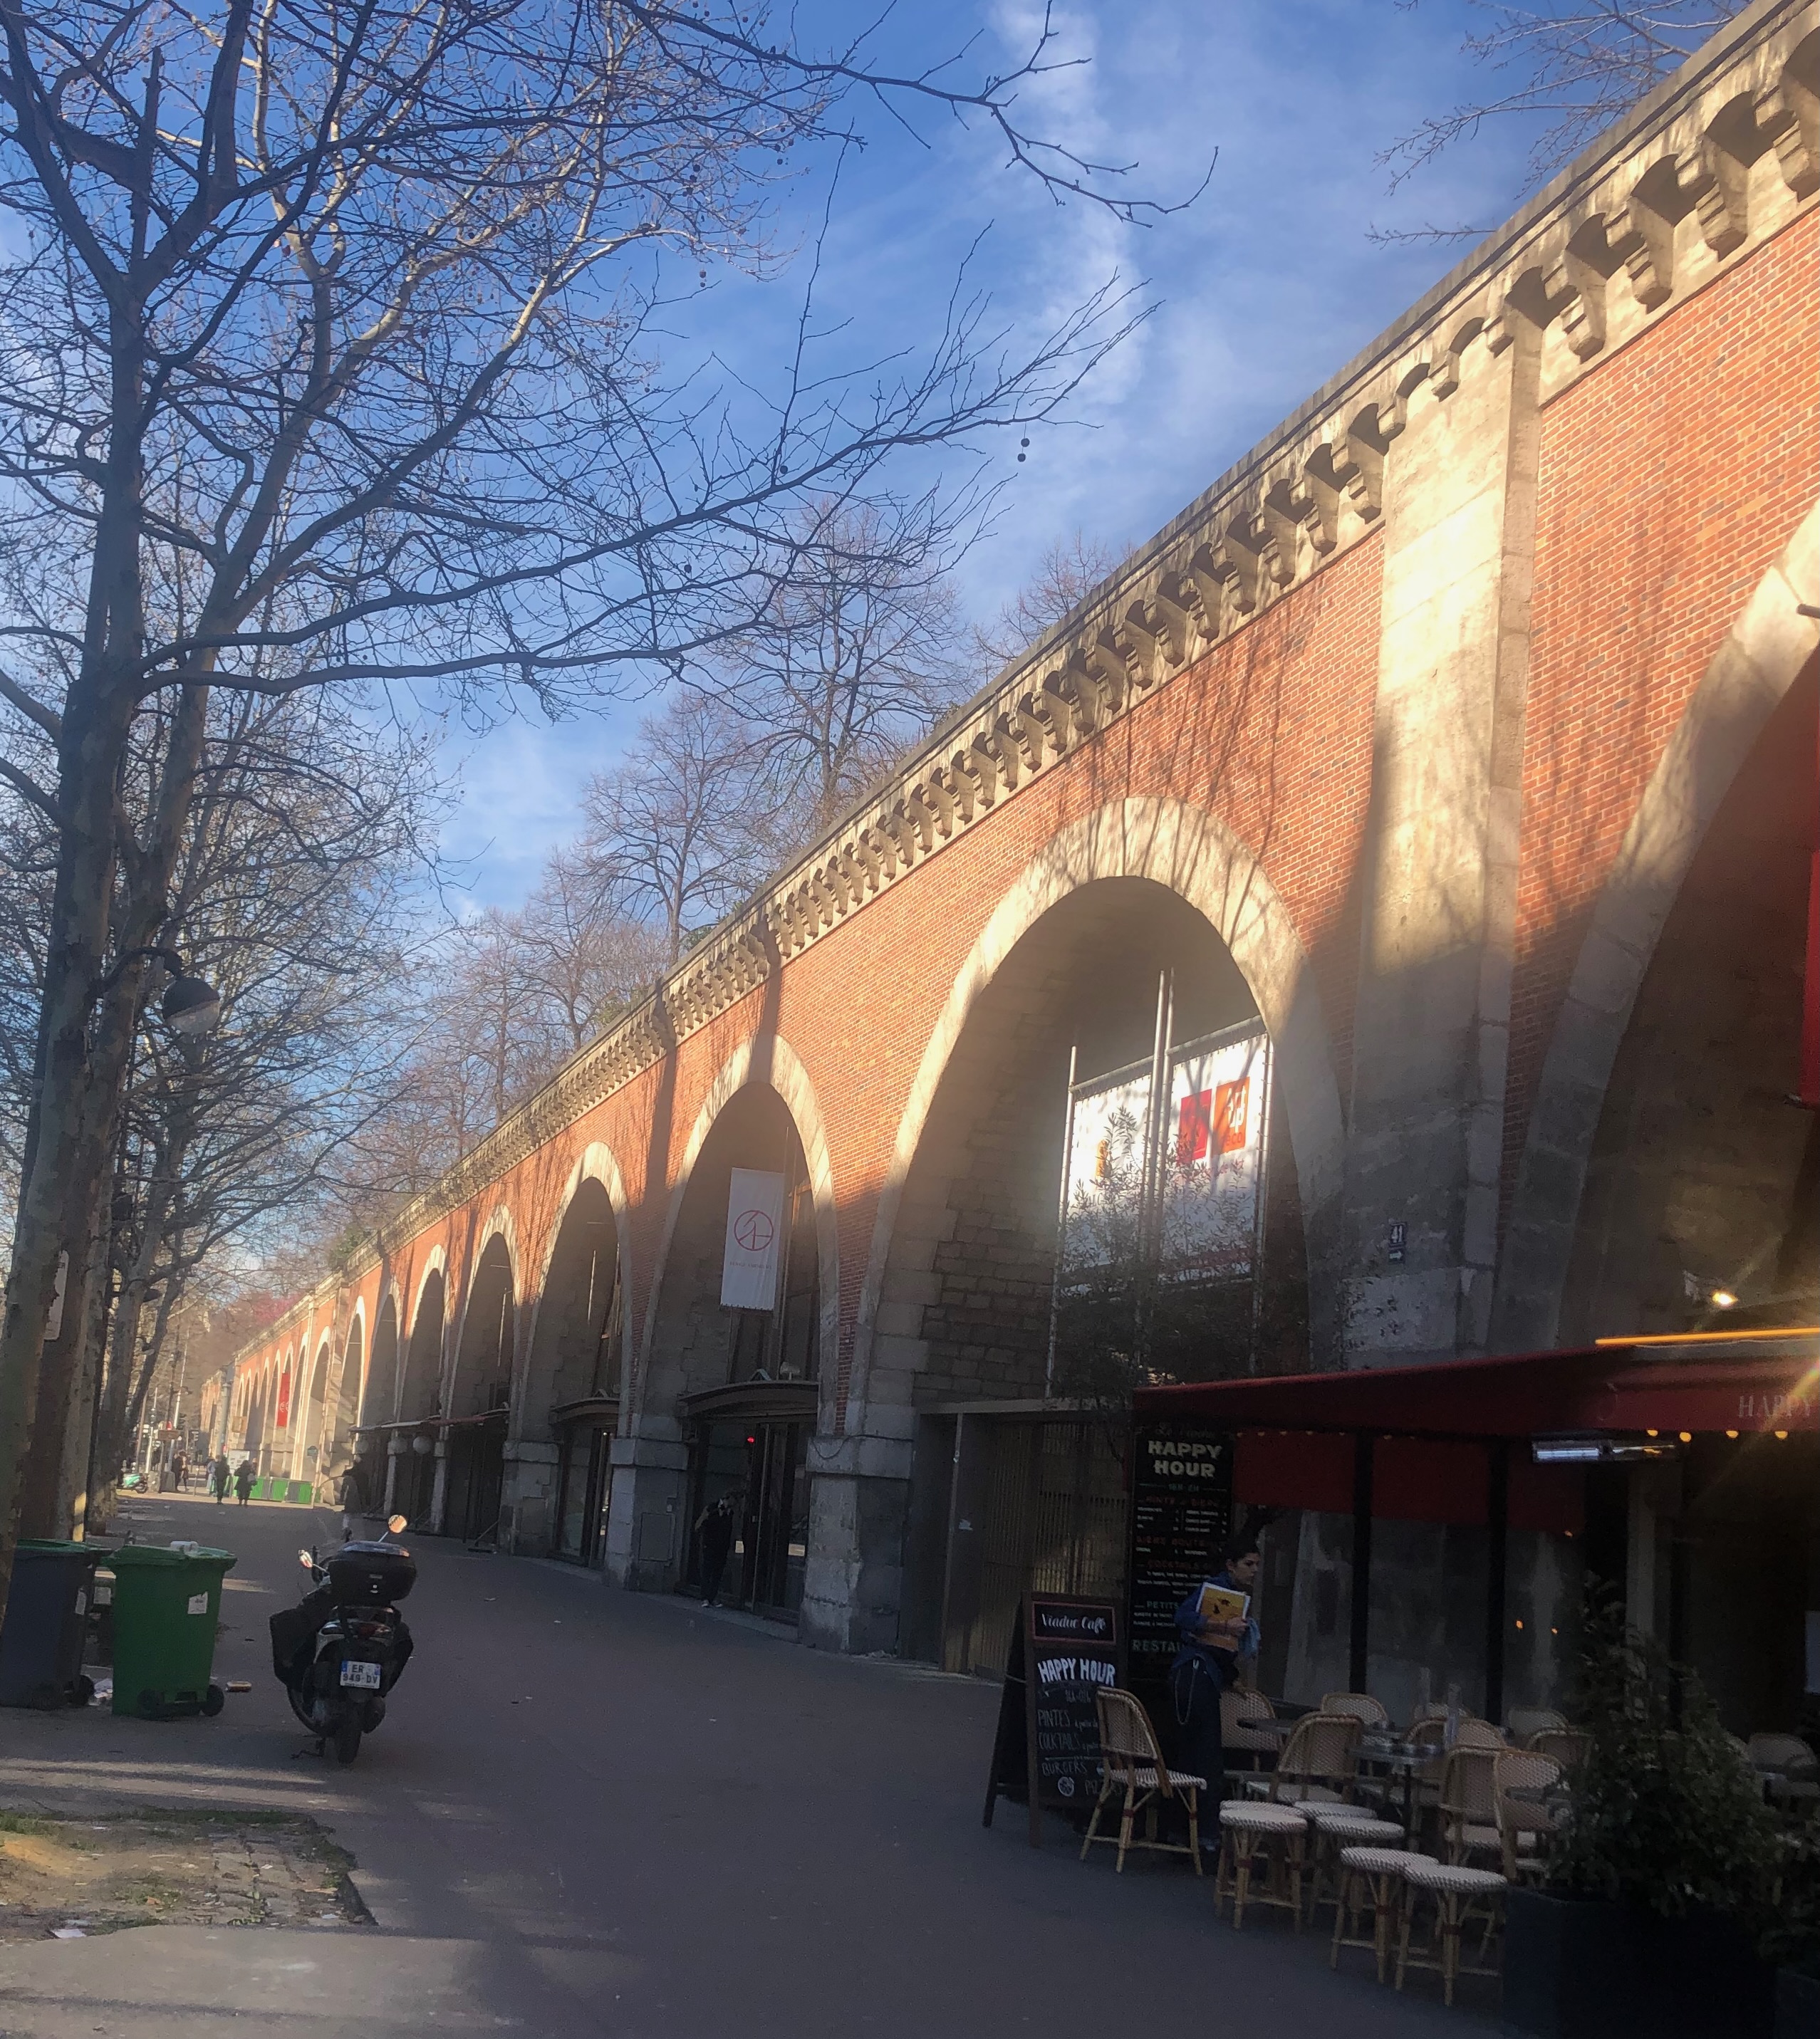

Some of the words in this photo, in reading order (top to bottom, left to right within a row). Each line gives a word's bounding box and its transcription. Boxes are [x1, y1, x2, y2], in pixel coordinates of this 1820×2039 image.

[1391, 1225, 1403, 1243] 41
[1148, 1439, 1223, 1460] HAPPY
[1153, 1459, 1217, 1479] HOUR
[1041, 1613, 1078, 1629] Viaduc
[352, 1664, 364, 1674] ER
[1037, 1657, 1076, 1684] HAPPY
[1079, 1657, 1116, 1687] HOUR
[1037, 1709, 1071, 1727] PINTES
[1038, 1731, 1081, 1751] COCKTAILS
[1041, 1760, 1087, 1777] BURGERS
